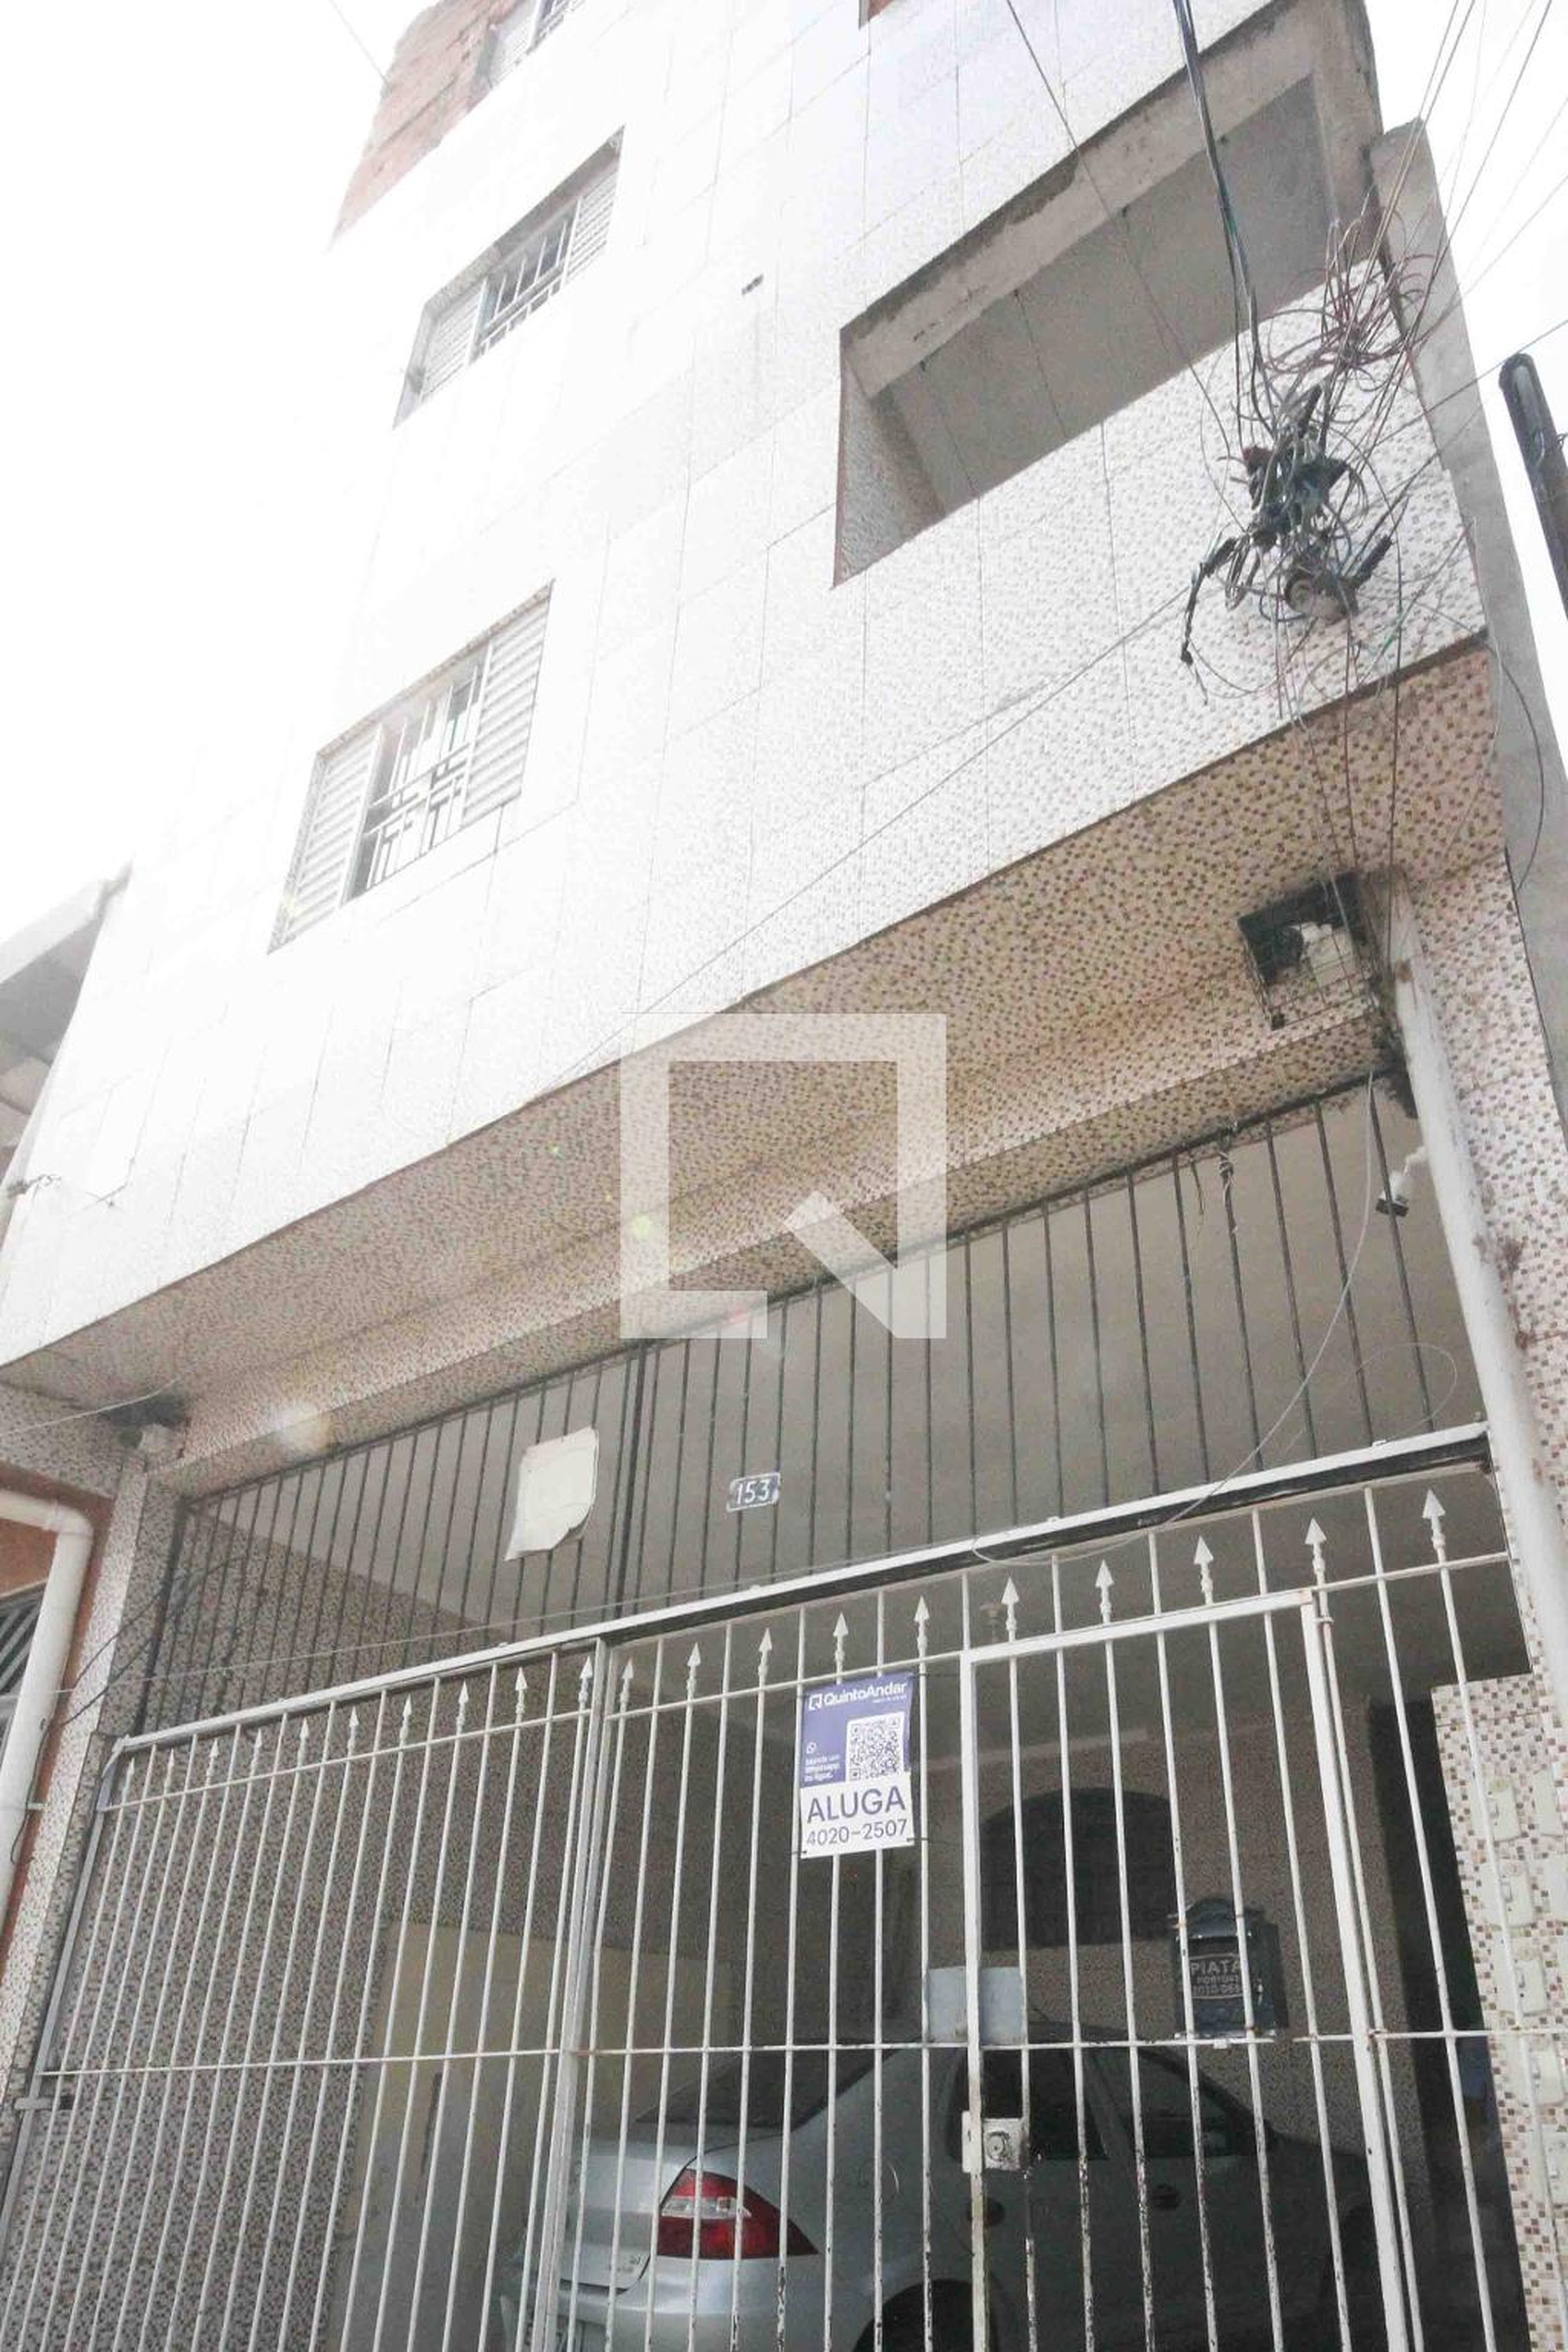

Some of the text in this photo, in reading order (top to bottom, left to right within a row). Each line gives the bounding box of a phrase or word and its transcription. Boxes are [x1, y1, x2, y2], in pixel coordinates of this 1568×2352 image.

[737, 1479, 770, 1505] 153
[824, 1682, 907, 1706] QuintoAndar
[807, 1786, 906, 1824] ALUGA
[806, 1819, 907, 1846] 4020-2507
